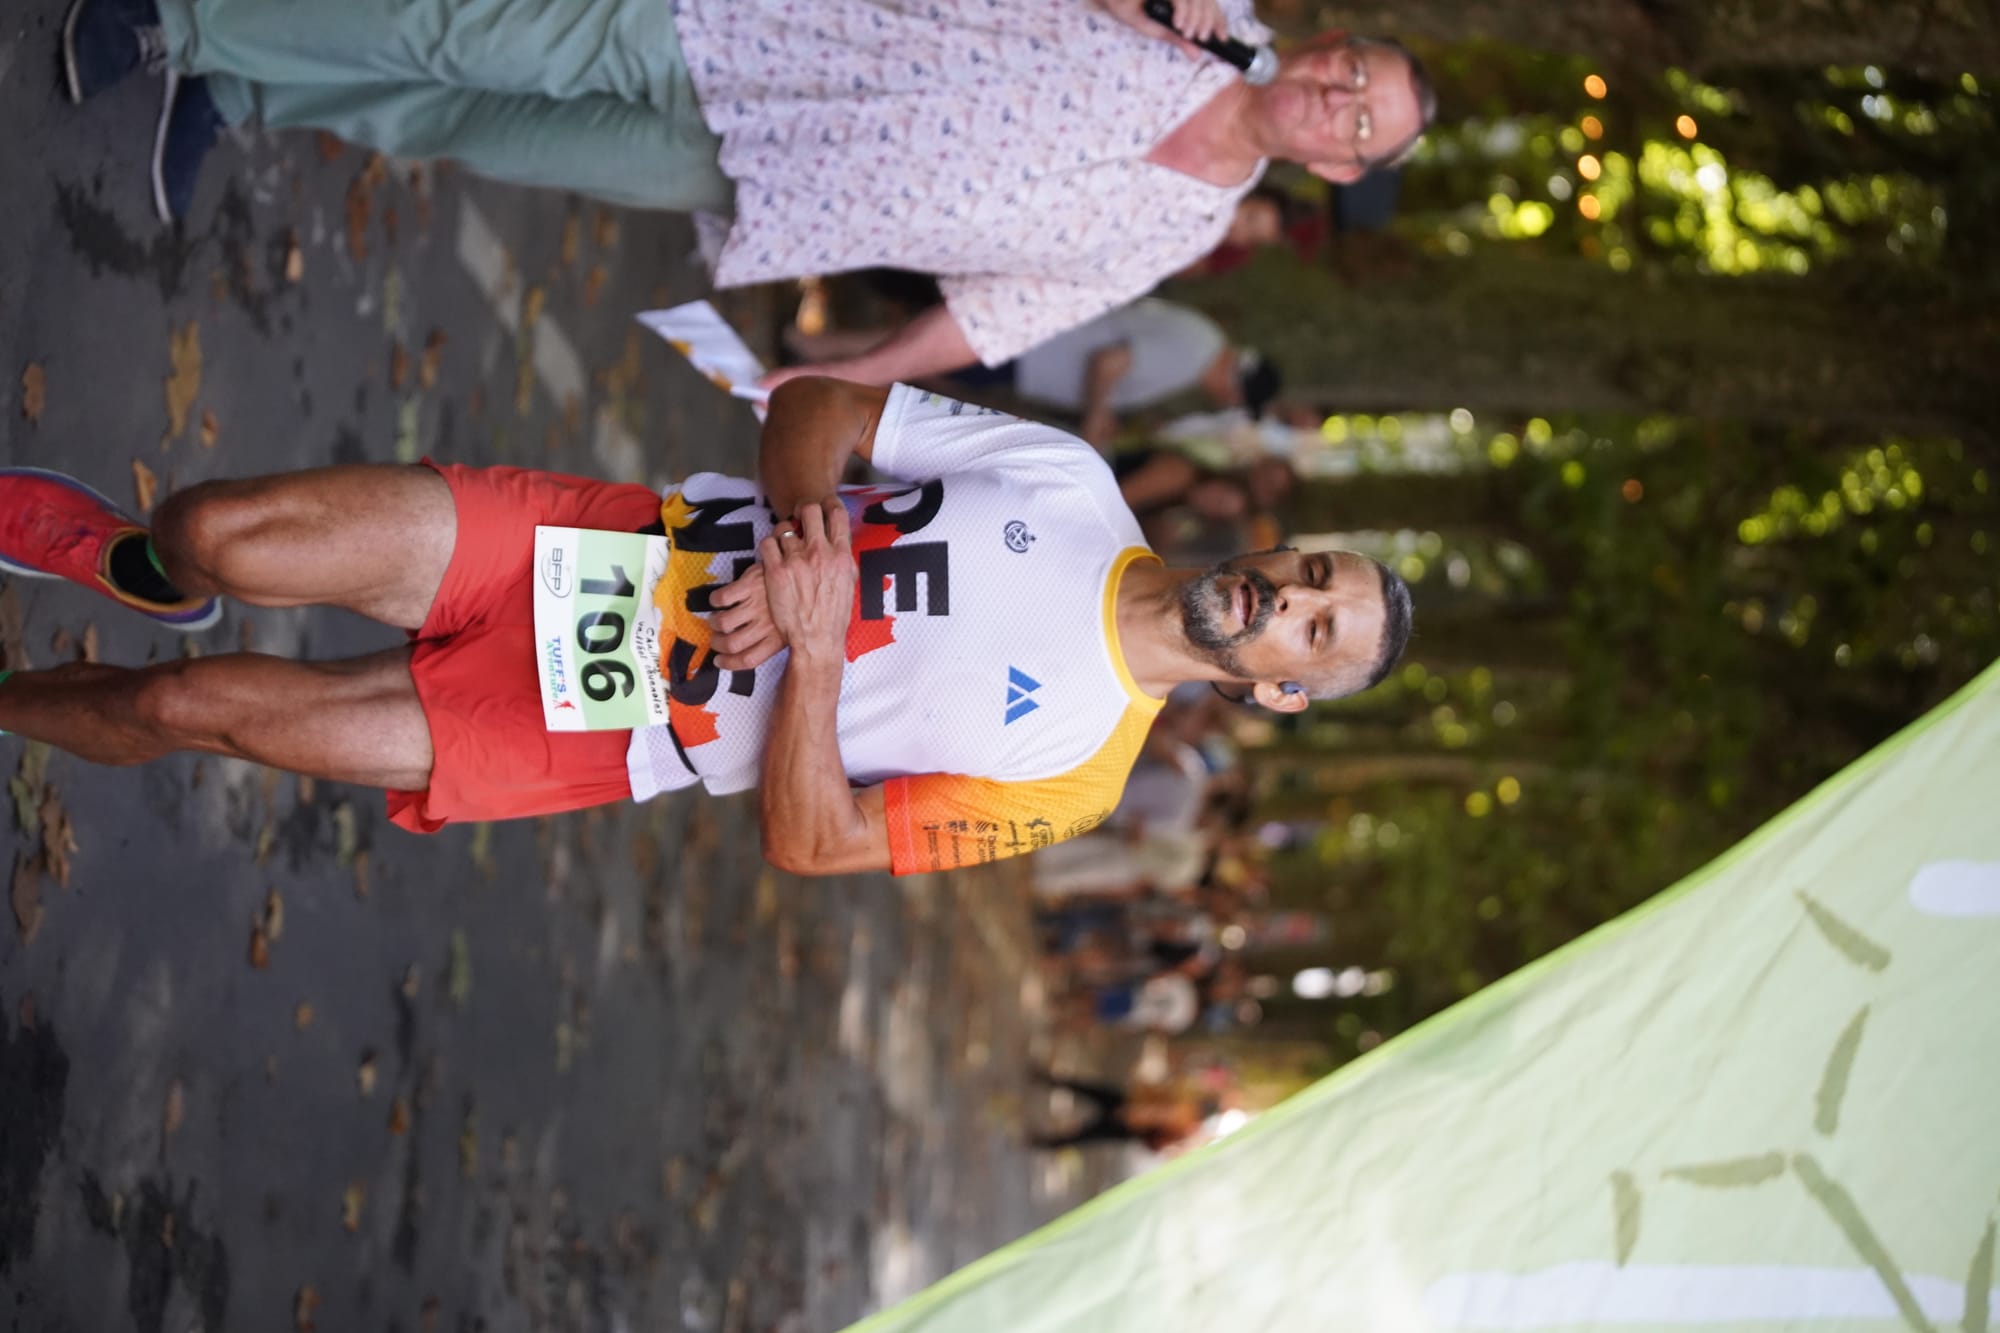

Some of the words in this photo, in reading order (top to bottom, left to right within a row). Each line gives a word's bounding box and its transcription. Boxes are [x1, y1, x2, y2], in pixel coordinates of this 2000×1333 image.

[551, 547, 564, 591] BFP
[576, 564, 636, 702] 106
[552, 636, 567, 693] TUFF'S
